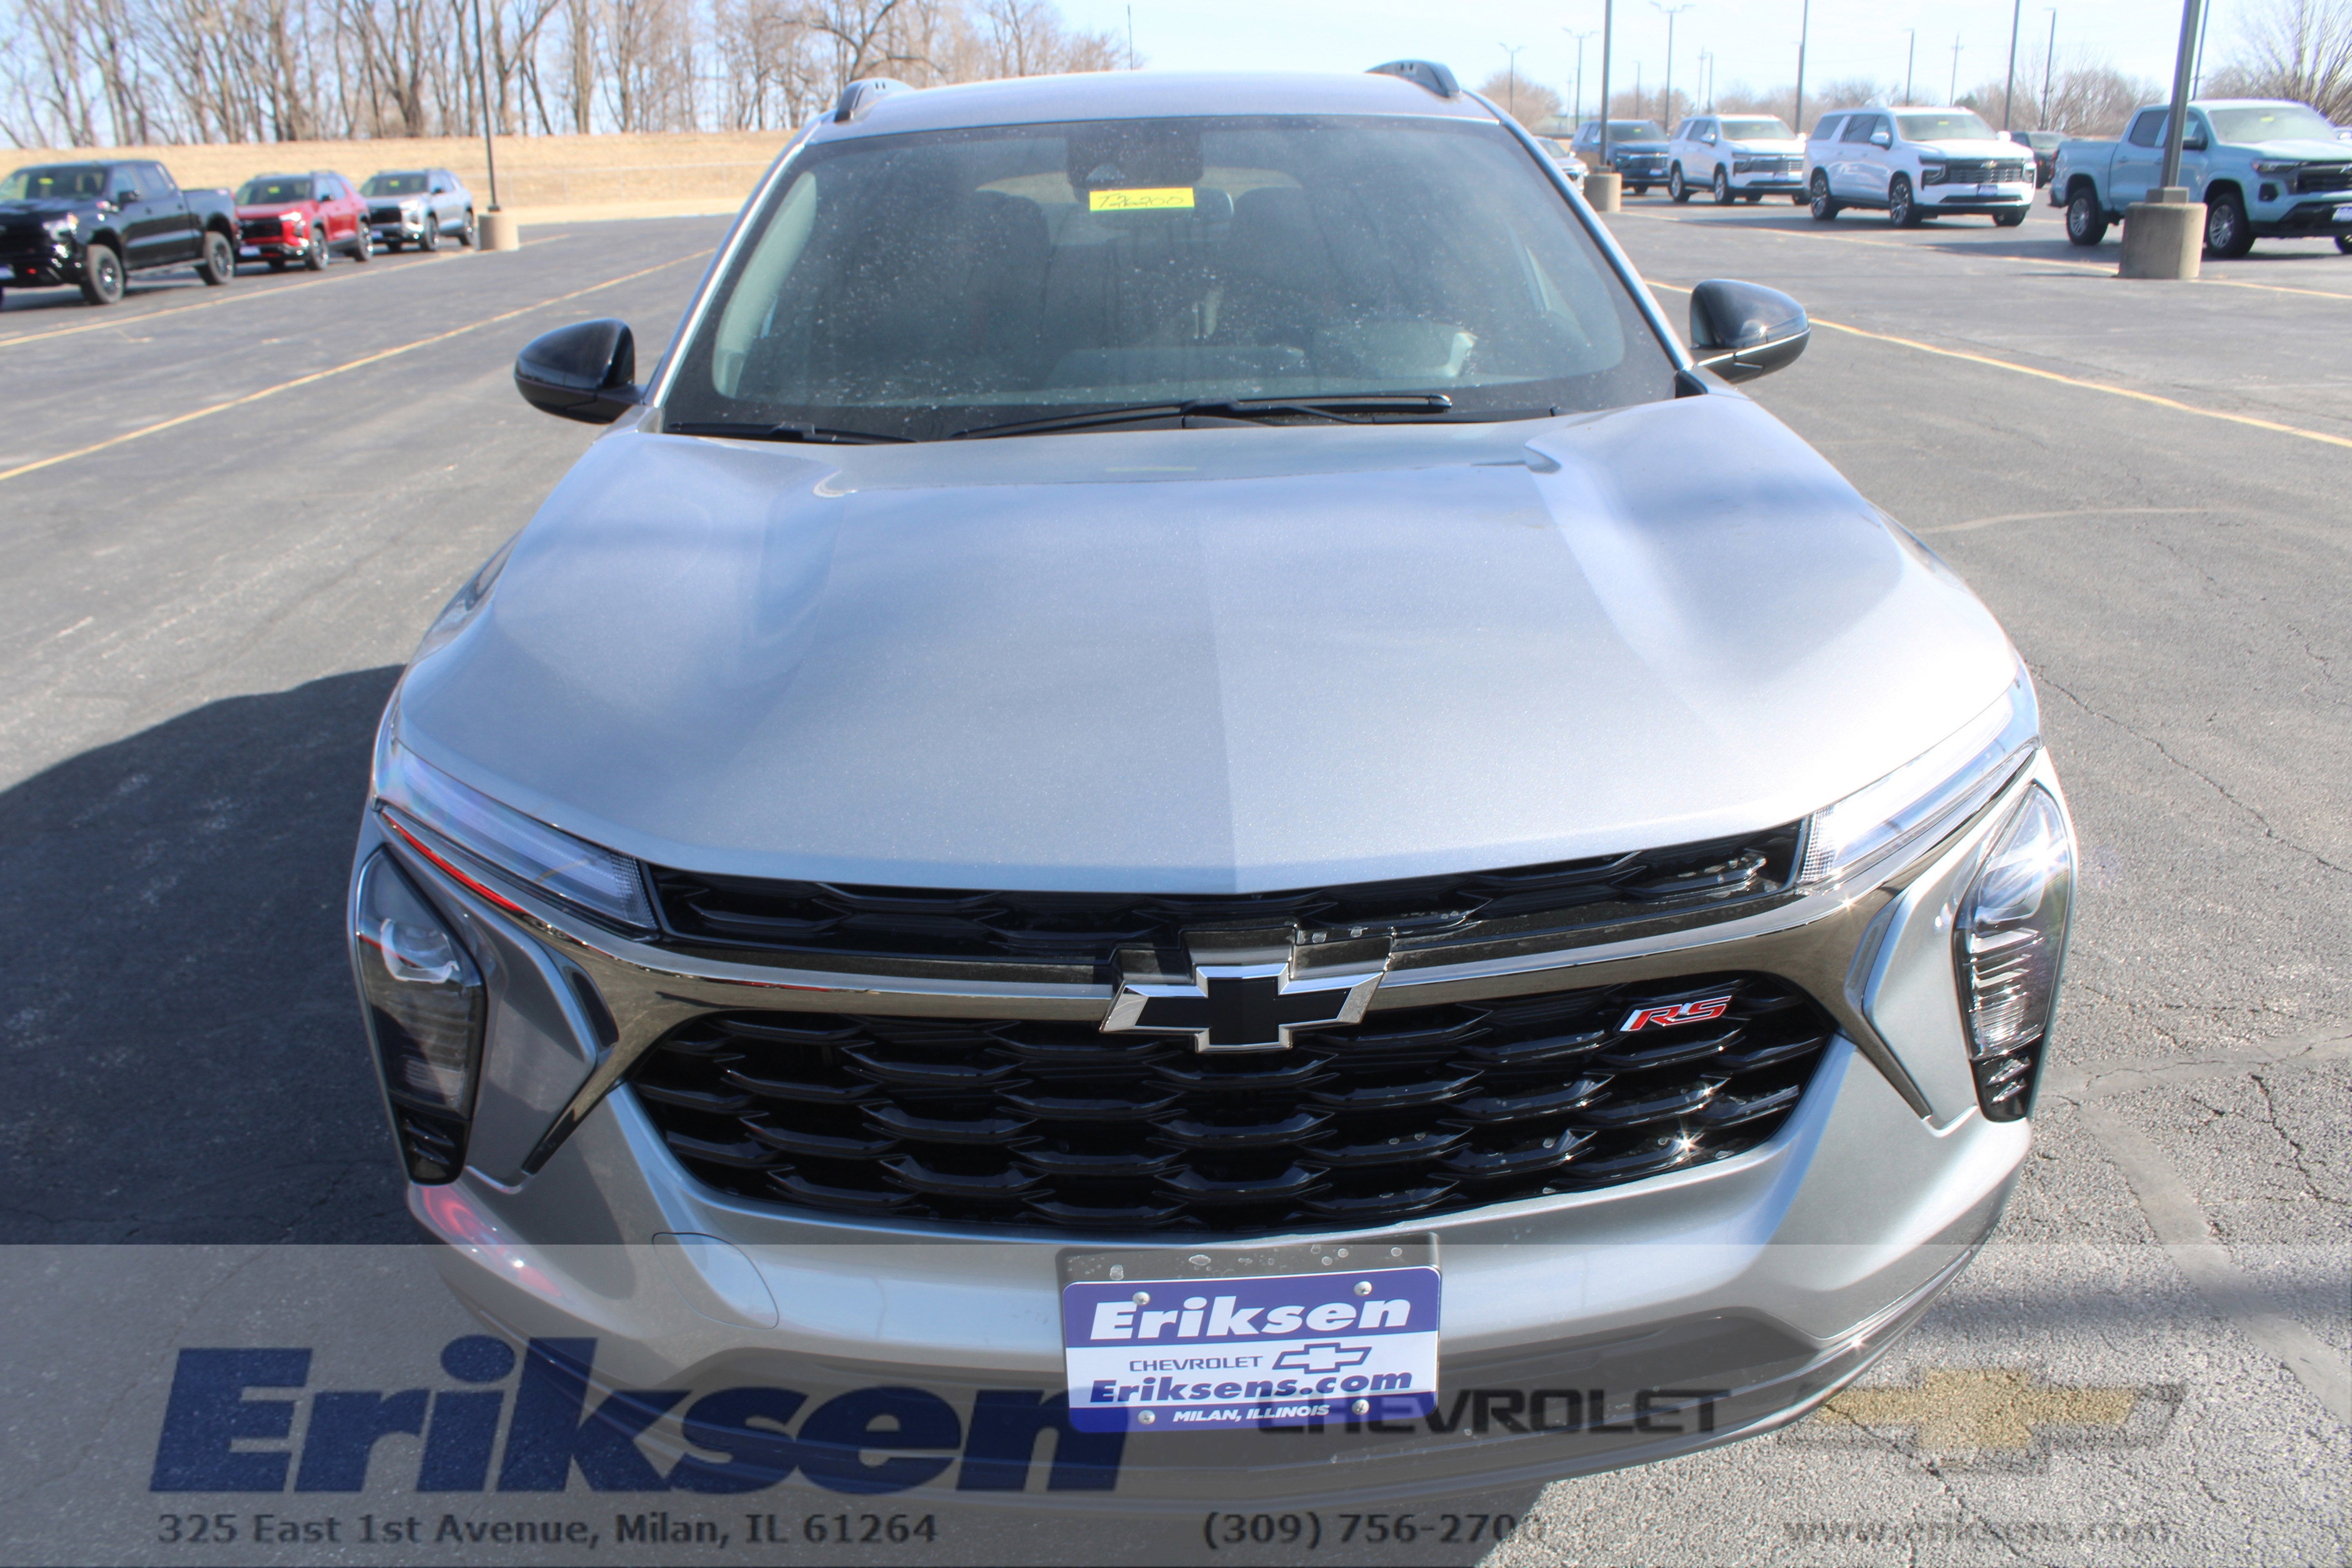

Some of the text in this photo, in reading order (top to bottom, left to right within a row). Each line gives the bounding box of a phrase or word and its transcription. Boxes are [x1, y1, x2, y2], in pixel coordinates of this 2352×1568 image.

[1619, 995, 1732, 1031] RS
[1090, 1295, 1411, 1340] Eriksen
[1129, 1356, 1263, 1372] CHEVROLET
[1090, 1371, 1412, 1403] Eriksens.com
[1172, 1404, 1330, 1422] MILAN, ILLINOIS
